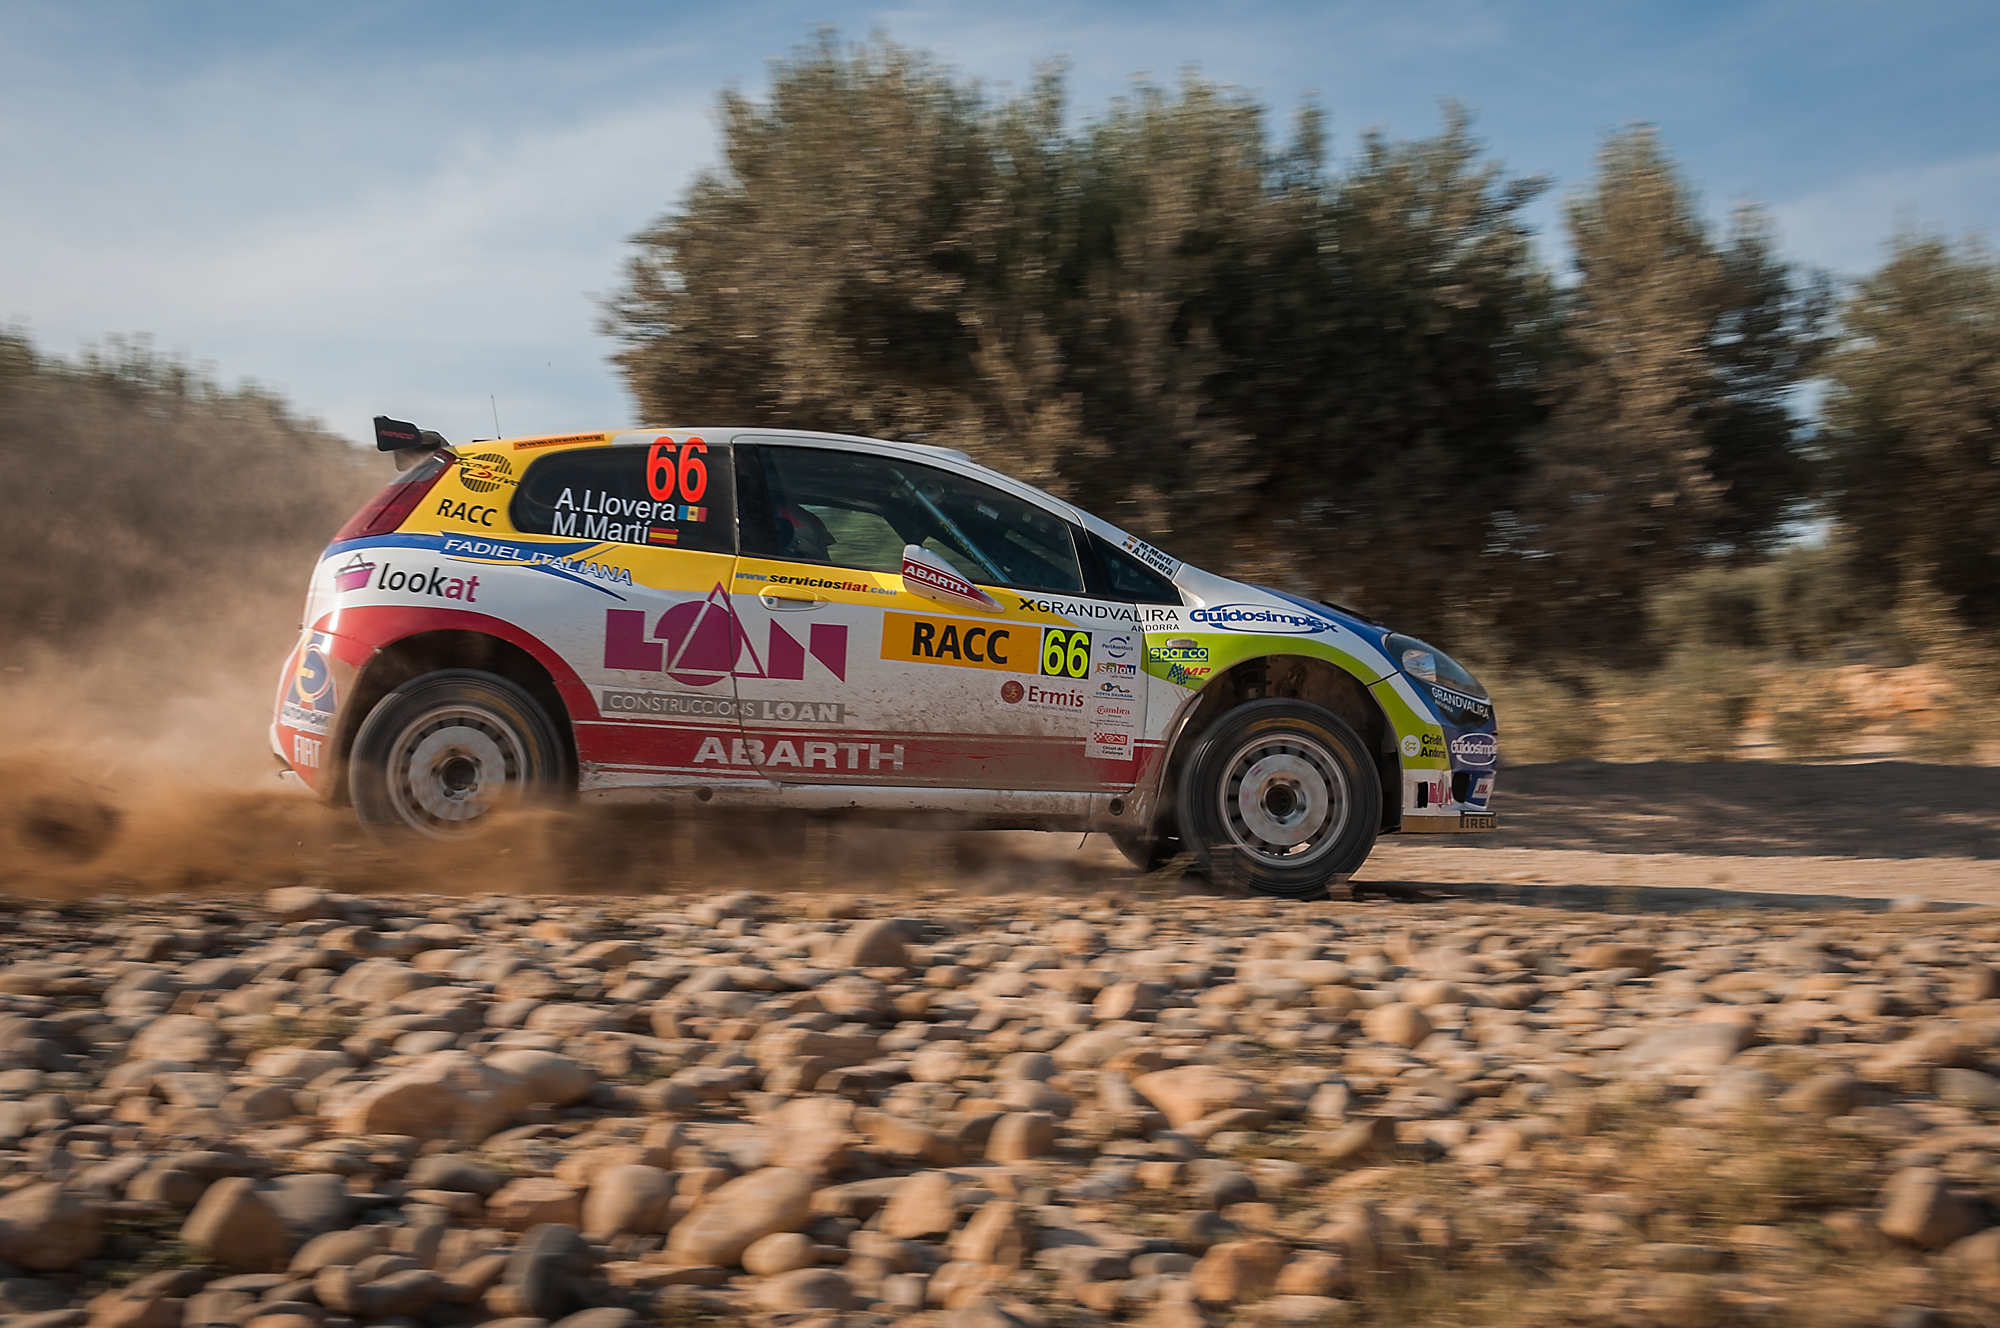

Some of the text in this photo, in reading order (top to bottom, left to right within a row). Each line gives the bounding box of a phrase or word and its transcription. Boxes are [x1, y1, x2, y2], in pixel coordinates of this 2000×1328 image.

[646, 435, 708, 503] 66
[437, 498, 498, 527] RACC
[554, 487, 676, 522] A.Llovera
[551, 511, 652, 544] M.Martí
[443, 538, 633, 587] FADIEL ITALIANA
[1131, 546, 1174, 577] A.Llovera
[377, 562, 480, 603] lookat
[735, 571, 898, 597] www.serviciosfiat.com
[904, 564, 969, 595] ABARTH
[1037, 600, 1180, 623] GRANDVALIRA
[1189, 608, 1340, 634] Guidosimplex
[603, 581, 849, 686] LOAN
[911, 621, 1011, 665] RACC
[1131, 623, 1180, 633] ANDORRA
[1042, 629, 1090, 678] 66
[1150, 648, 1208, 661] sparco
[1182, 667, 1211, 676] MP
[610, 694, 838, 721] CONSTRUCCIONS LOAN
[1028, 685, 1084, 708] Ermis
[1431, 686, 1490, 720] GRANDVALIRA
[294, 734, 322, 769] FIAT
[693, 736, 904, 770] ABARTH
